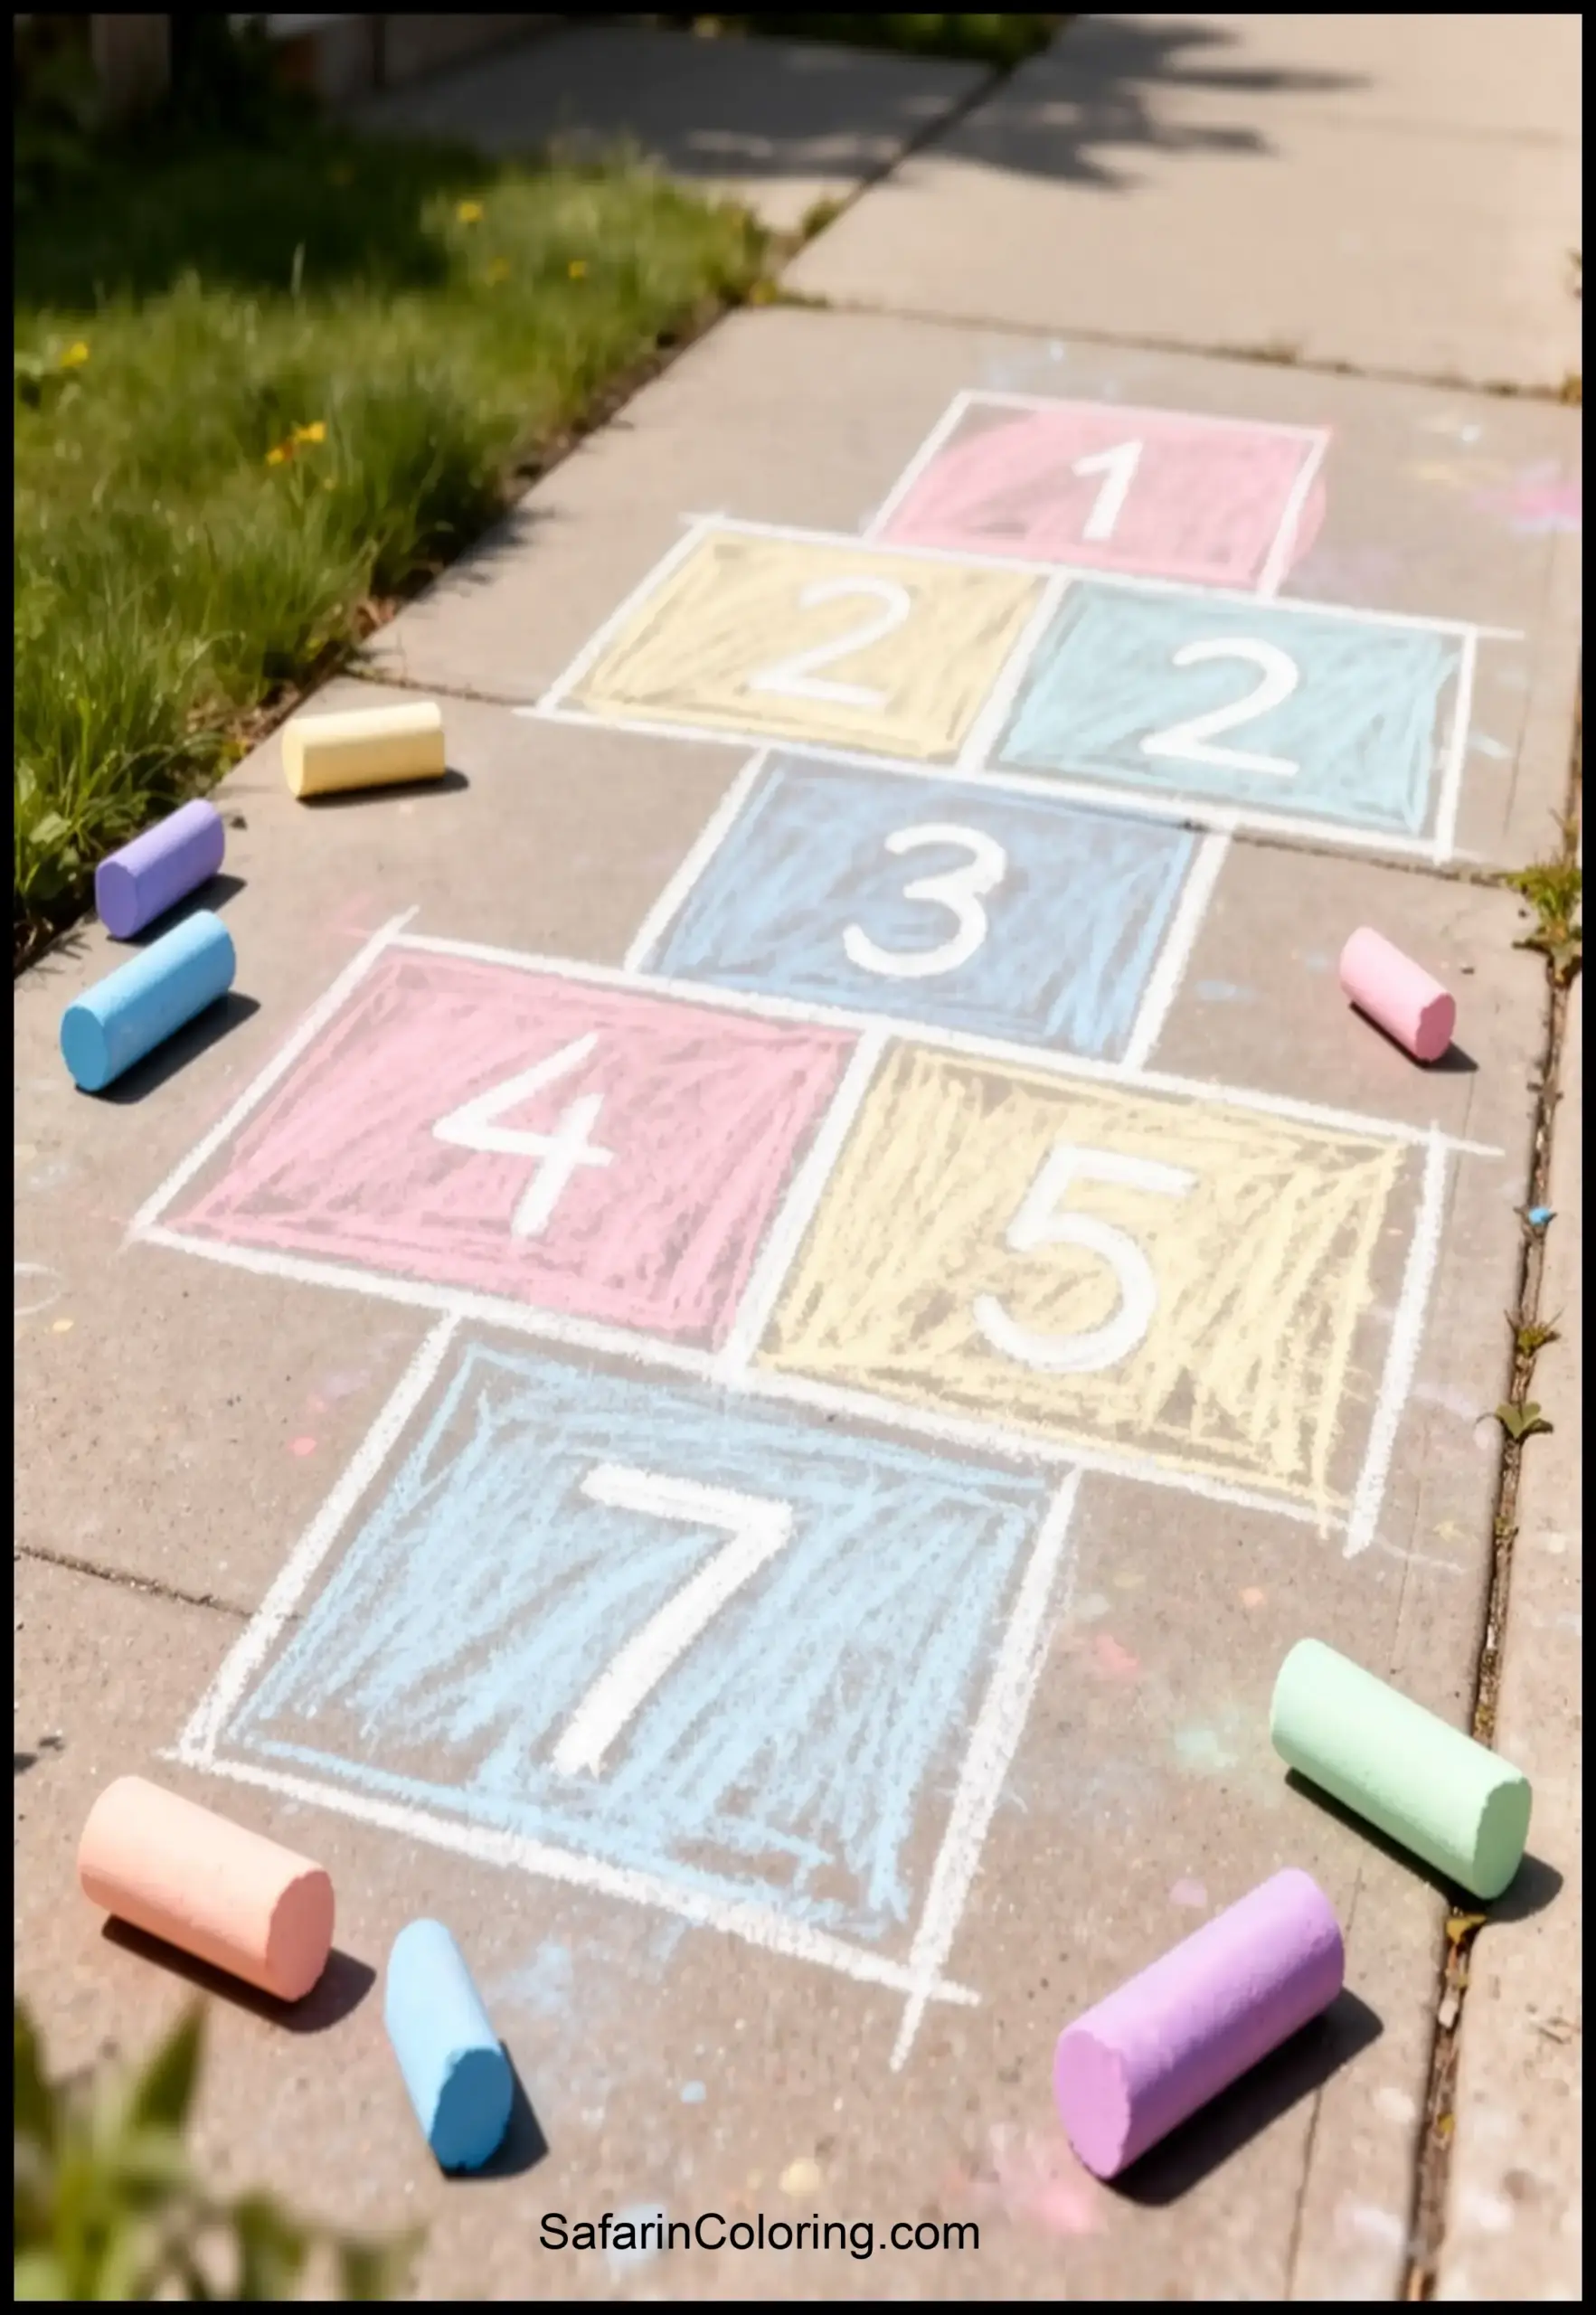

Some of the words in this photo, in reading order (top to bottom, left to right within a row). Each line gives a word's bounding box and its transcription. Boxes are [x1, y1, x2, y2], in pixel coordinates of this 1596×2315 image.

[1071, 440, 1145, 542] 1
[749, 575, 911, 708] 2
[1139, 638, 1300, 777] 2
[842, 823, 1008, 978] 3
[431, 1032, 615, 1244] 4
[973, 1142, 1200, 1373] 5
[551, 1462, 795, 1776] 7
